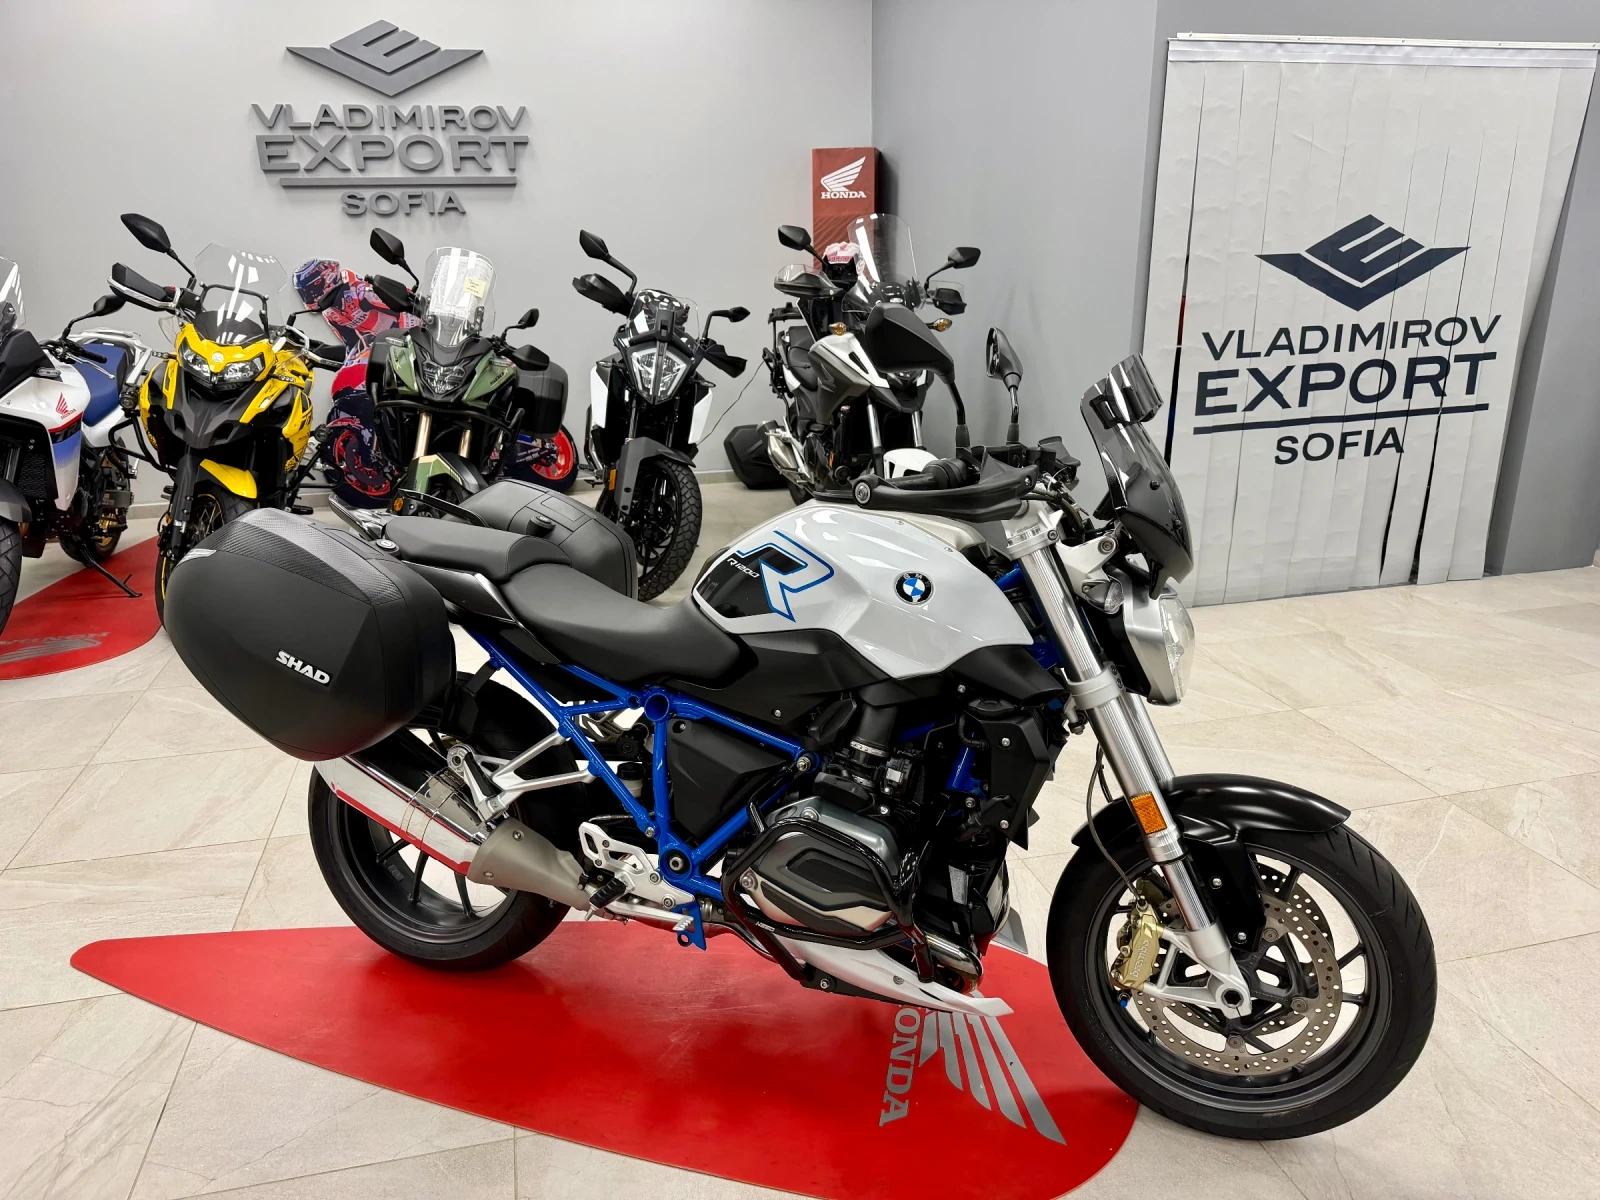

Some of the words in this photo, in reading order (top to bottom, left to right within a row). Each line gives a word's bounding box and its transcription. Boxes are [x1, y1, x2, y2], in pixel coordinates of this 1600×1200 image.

[251, 104, 526, 130] VLADIMIROV
[256, 134, 529, 171] EXPORT
[341, 190, 467, 215] SOFIA
[820, 190, 867, 199] HONDA
[1202, 314, 1502, 361] VLADIMIROV
[1195, 352, 1497, 416] EXPORT
[1274, 427, 1405, 465] SOFIA
[275, 650, 331, 684] SHAD
[1130, 940, 1150, 978] brembo
[879, 1006, 921, 1127] ONDA
